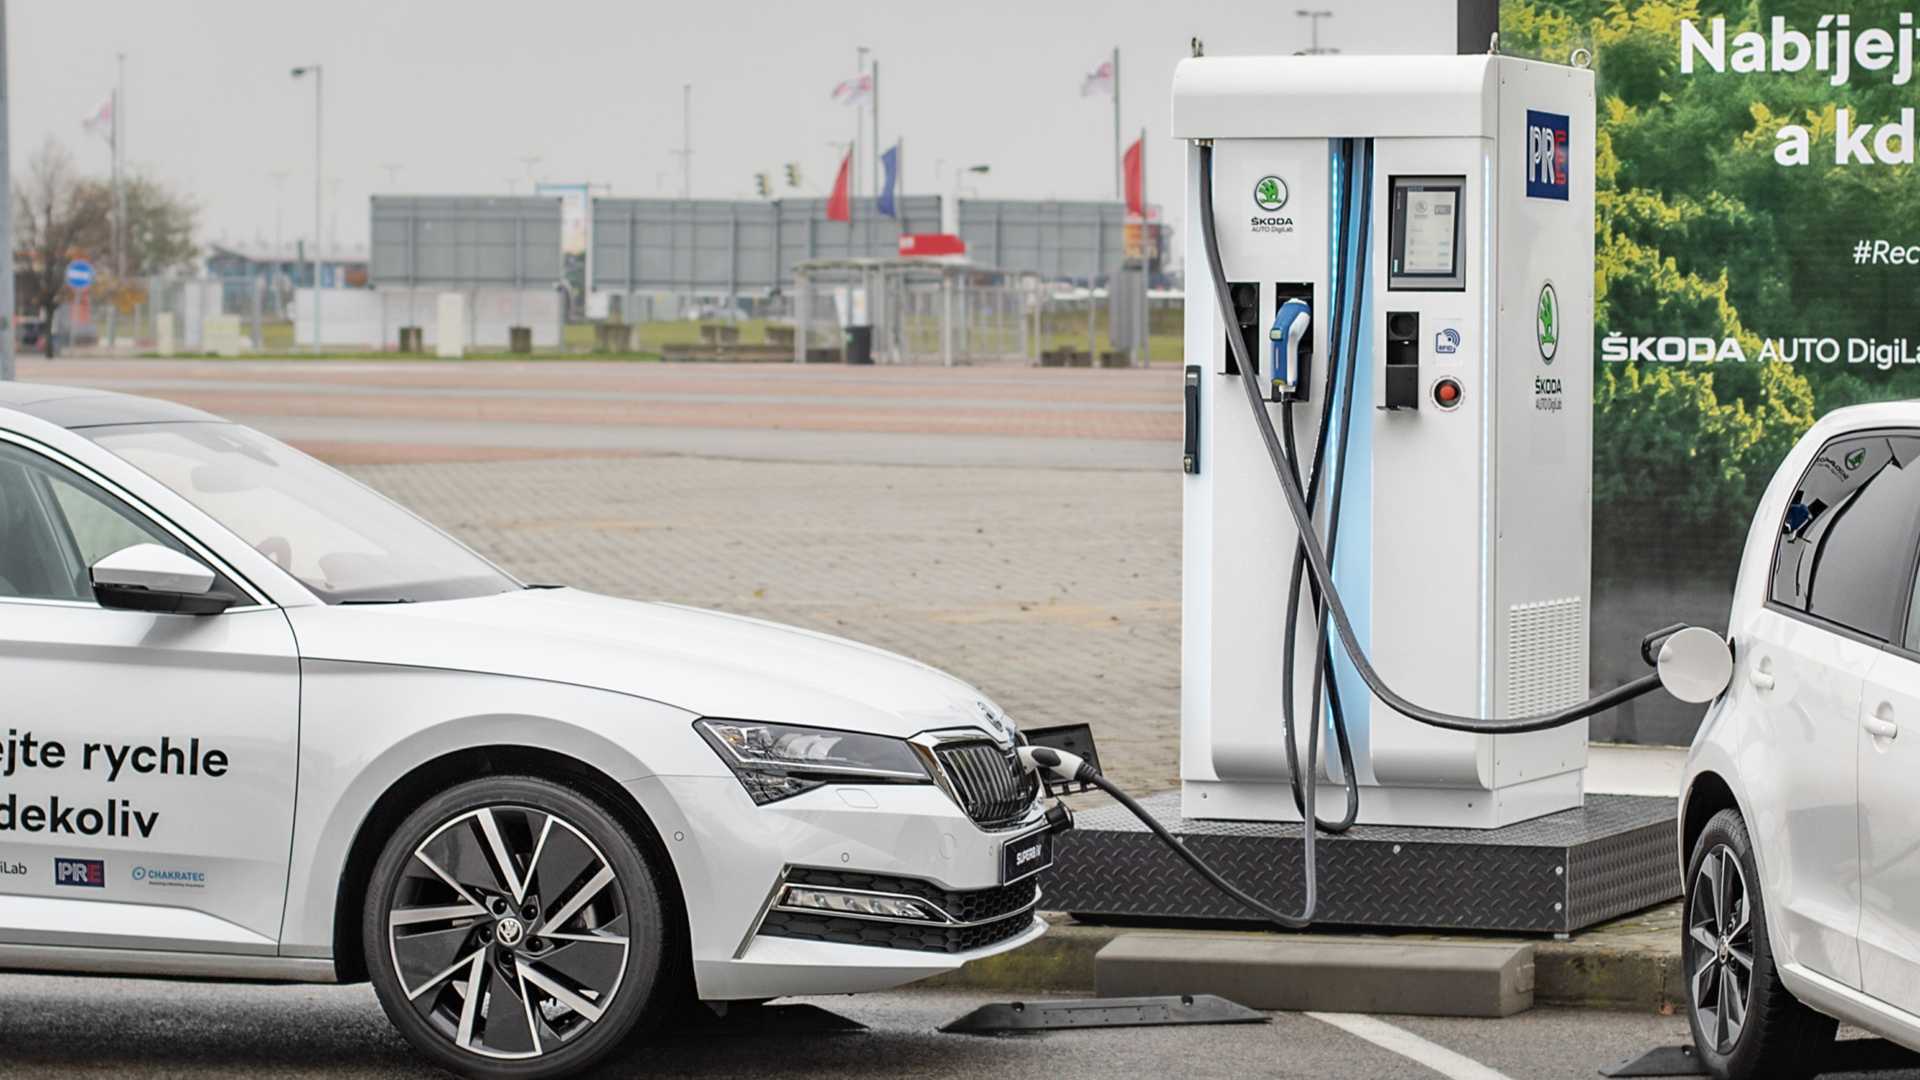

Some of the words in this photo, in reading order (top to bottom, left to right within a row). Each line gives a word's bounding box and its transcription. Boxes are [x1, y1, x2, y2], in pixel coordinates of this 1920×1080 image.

[1680, 12, 1920, 87] Nabíjej
[1773, 125, 1810, 166] a
[1835, 108, 1915, 165] kd
[1529, 125, 1567, 185] PRE
[1251, 216, 1293, 225] ŠKODA
[1852, 240, 1920, 265] #Rec
[1601, 331, 1747, 363] ŠKODA
[1758, 337, 1841, 363] AUTO
[1535, 376, 1562, 394] ŠKODA
[0, 728, 66, 776] jte
[82, 736, 229, 782] rychle
[0, 793, 160, 838] dekoliv
[58, 861, 101, 883] PRE
[147, 869, 205, 882] CHAKRATEC
